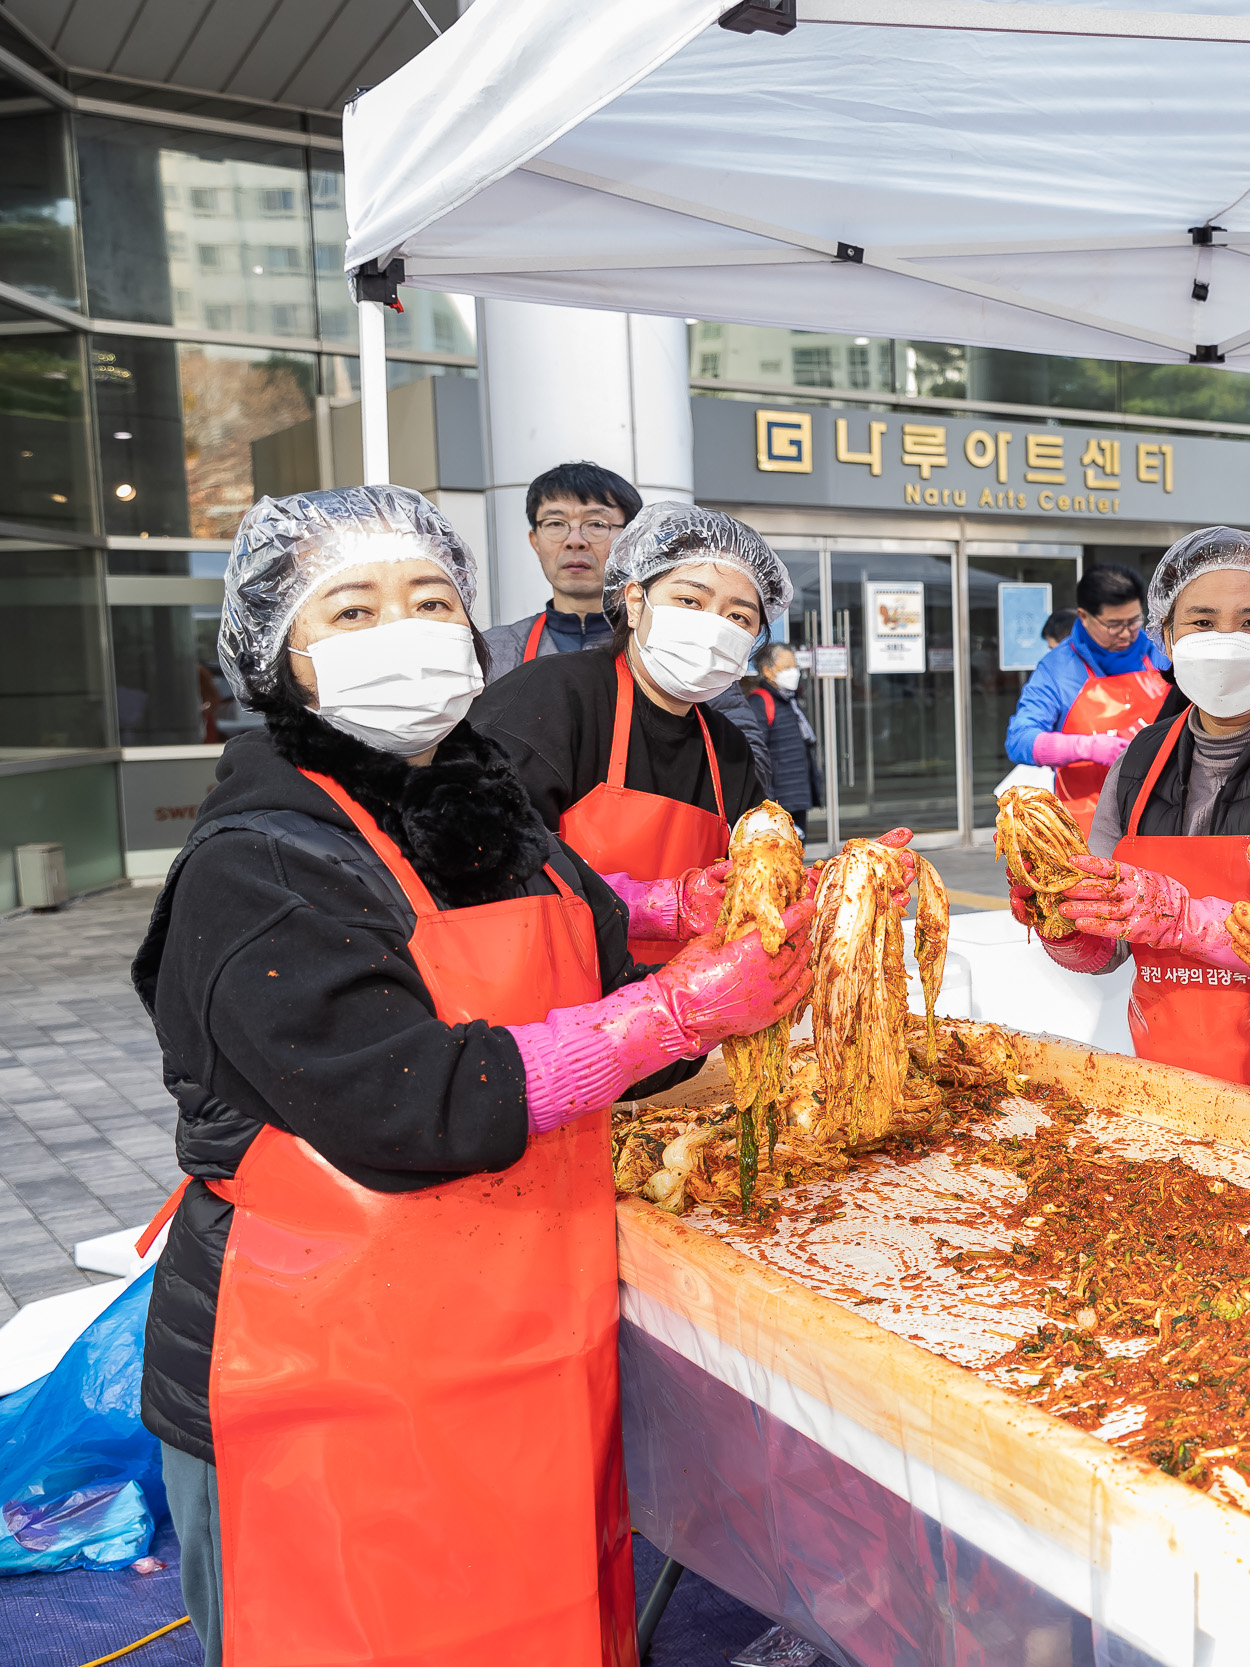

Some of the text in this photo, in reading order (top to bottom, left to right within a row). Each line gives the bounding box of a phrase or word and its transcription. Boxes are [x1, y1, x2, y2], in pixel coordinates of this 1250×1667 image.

[836, 418, 1173, 493] 나루아트센터
[904, 482, 1120, 513] Naru Arts Center
[1140, 966, 1162, 982] 광진
[1165, 967, 1203, 984] 사랑의
